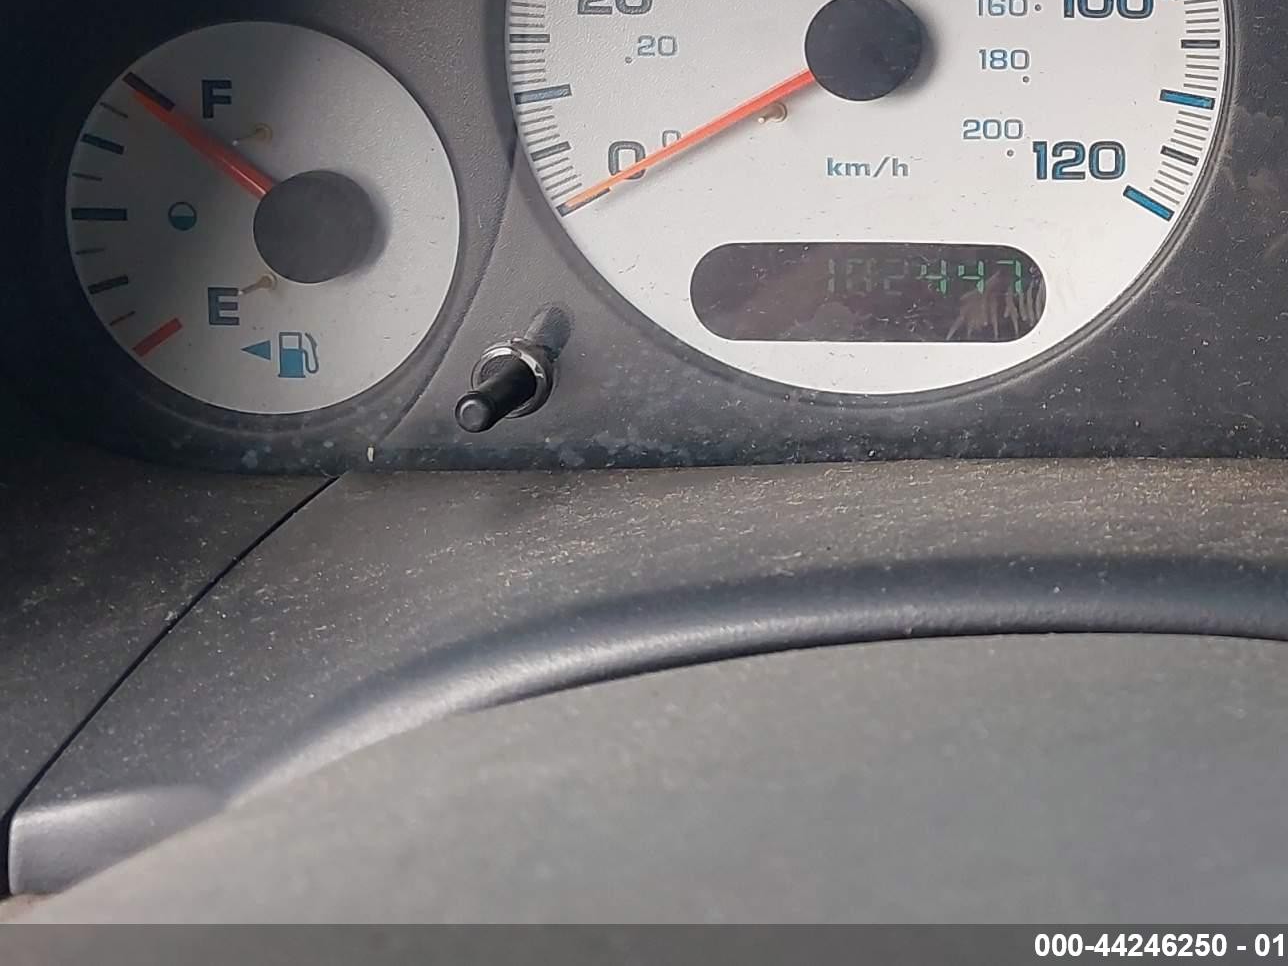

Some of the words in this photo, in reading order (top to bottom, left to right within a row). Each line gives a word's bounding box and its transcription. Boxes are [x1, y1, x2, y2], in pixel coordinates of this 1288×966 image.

[637, 35, 677, 56] 20
[978, 49, 1030, 70] 180
[202, 79, 232, 118] F
[962, 119, 1023, 140] 200
[608, 140, 646, 180] 0
[827, 157, 909, 177] km/h
[1032, 141, 1126, 180] 120
[208, 287, 240, 326] E
